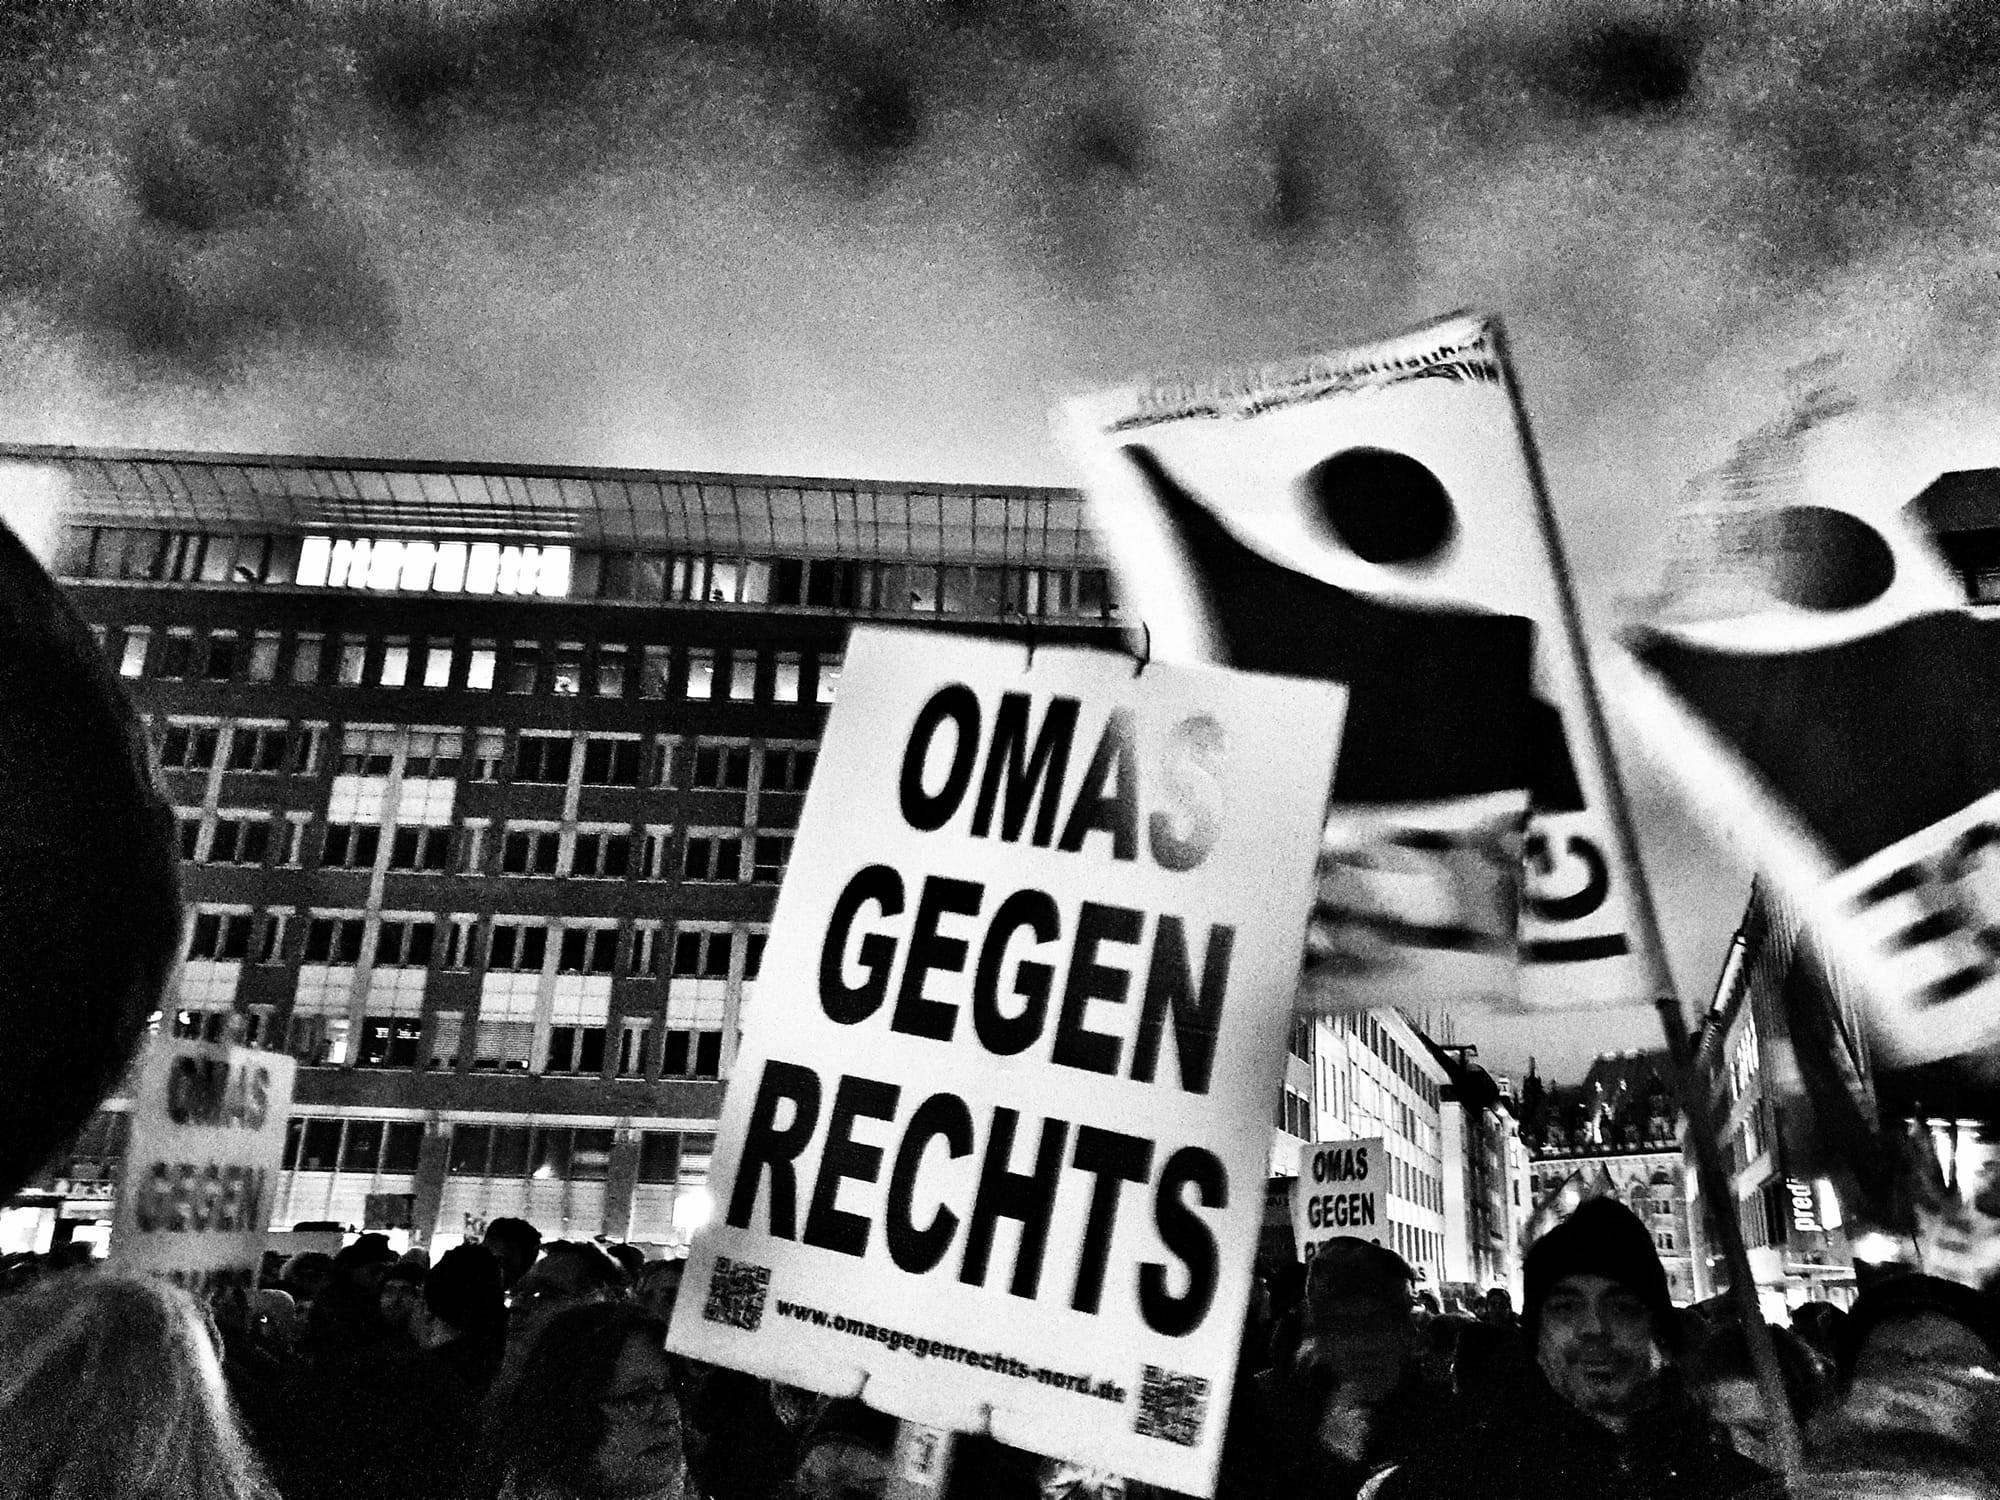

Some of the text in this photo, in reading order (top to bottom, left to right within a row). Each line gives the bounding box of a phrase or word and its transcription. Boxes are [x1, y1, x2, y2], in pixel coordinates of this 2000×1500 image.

[899, 683, 1226, 872] OMAS
[818, 863, 1235, 1096] GEGEN
[724, 1059, 1229, 1338] RECHTS
[1307, 1192, 1376, 1229] GEGEN
[1311, 1147, 1369, 1184] OMAS
[776, 1299, 1127, 1404] www.omasgegenrechts-nord.de
